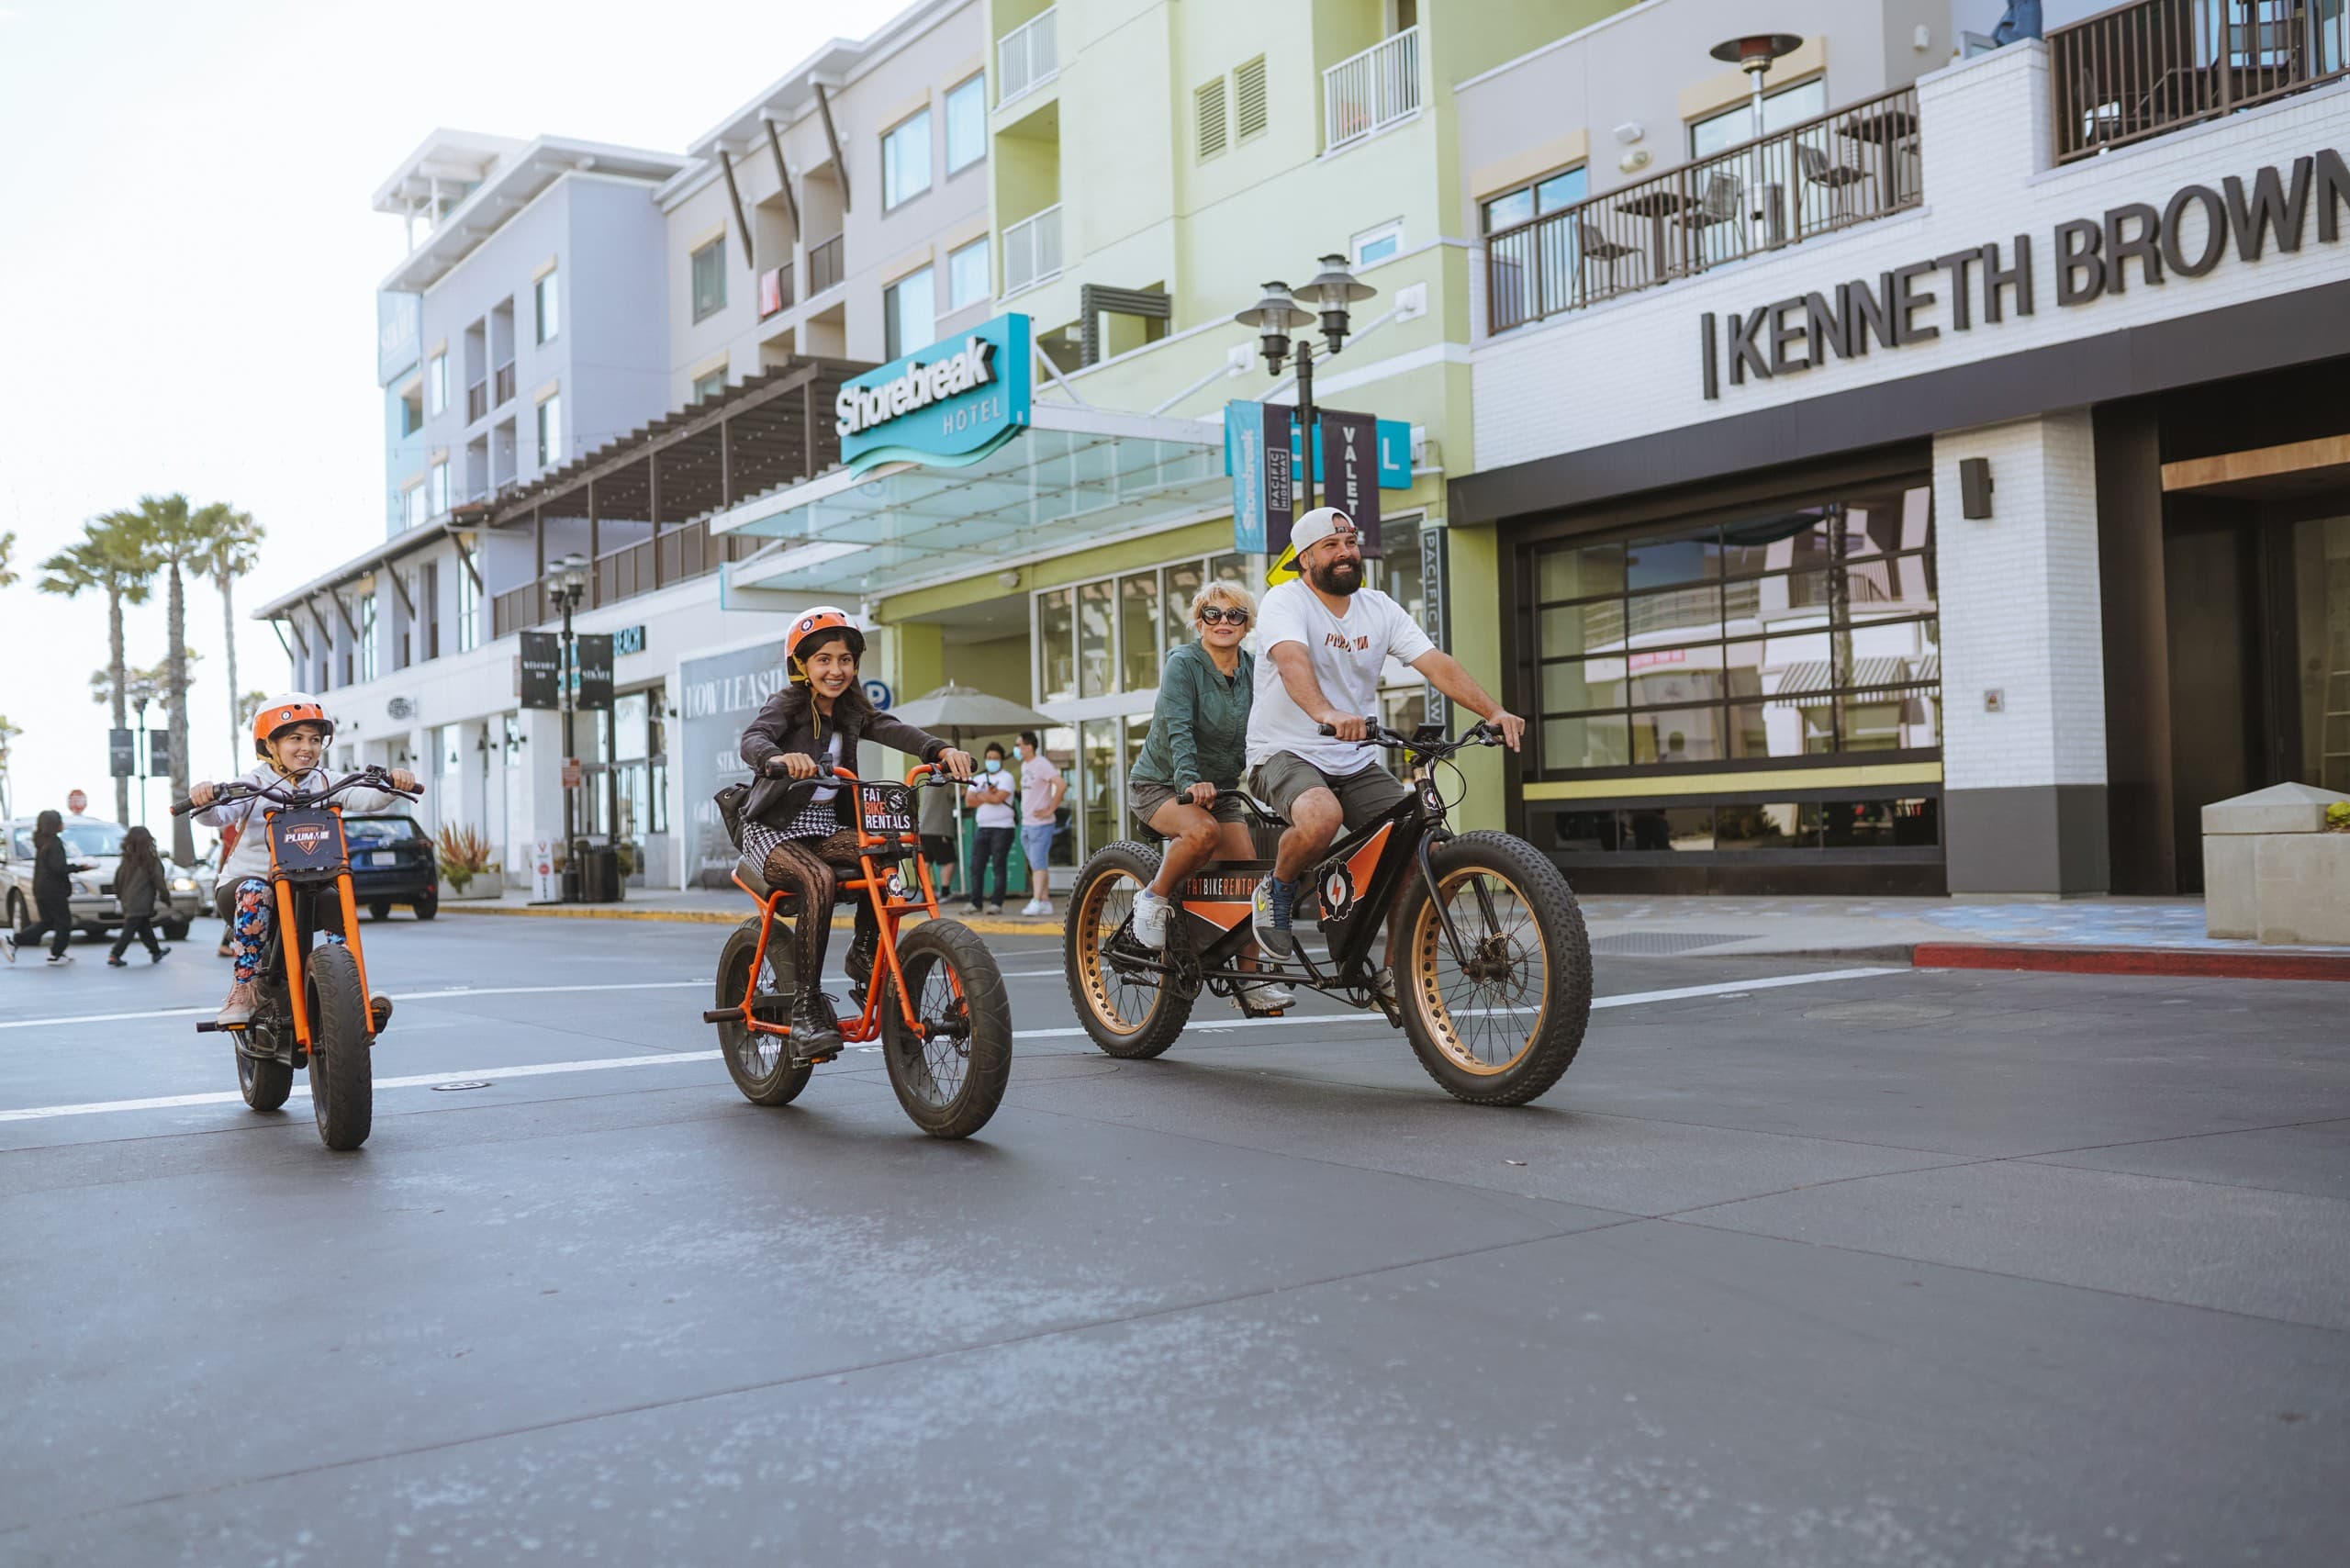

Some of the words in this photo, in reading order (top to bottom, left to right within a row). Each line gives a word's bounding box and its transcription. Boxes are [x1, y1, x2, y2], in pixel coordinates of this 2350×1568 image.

[1728, 234, 2034, 385] KENNETH
[835, 335, 995, 437] Shorebreak
[943, 397, 1002, 436] HOTEL
[1270, 453, 1280, 507] PACIFIC
[1280, 454, 1288, 508] HIDEAWAY
[1343, 427, 1359, 515] VALET
[1425, 534, 1438, 622] PACIFIC
[686, 680, 720, 719] NOW
[724, 668, 783, 713] LEASI
[863, 788, 881, 801] FAT
[864, 801, 887, 815] BIKE
[866, 815, 911, 829] RENTALS
[1187, 878, 1264, 895] FATBIKERENTA
